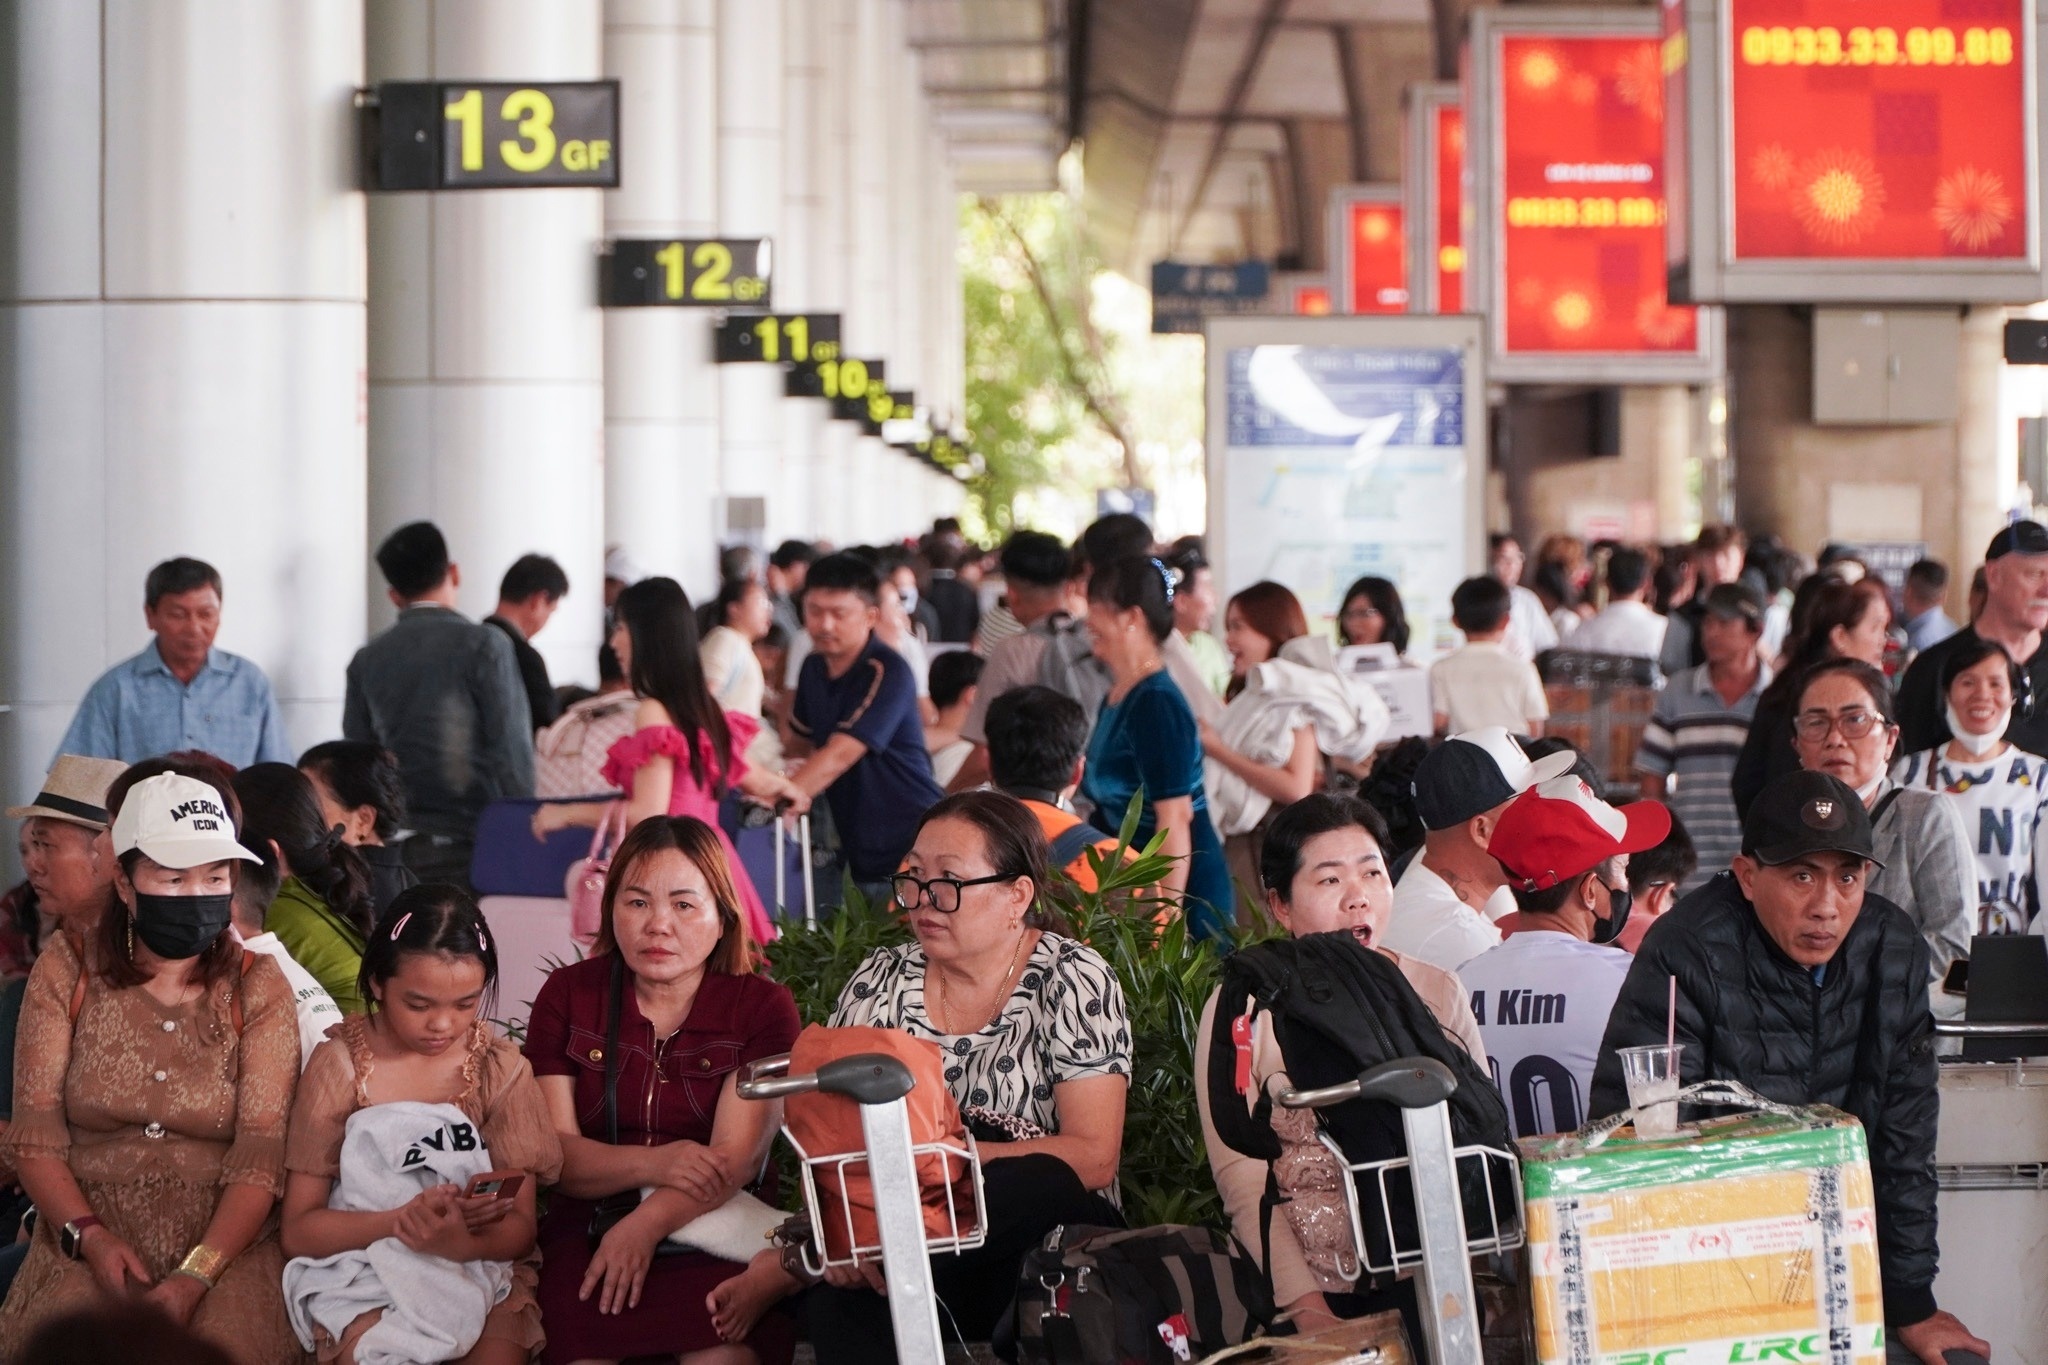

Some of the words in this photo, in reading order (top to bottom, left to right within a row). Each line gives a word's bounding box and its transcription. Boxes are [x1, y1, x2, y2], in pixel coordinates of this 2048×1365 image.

[1743, 26, 2014, 66] 0933.33.99.88
[445, 89, 557, 172] 13
[560, 139, 611, 171] GF
[655, 242, 733, 300] 12
[754, 316, 809, 362] 11
[816, 359, 869, 399] 10
[193, 819, 219, 831] ICON
[1497, 989, 1566, 1025] Kim
[1728, 1335, 1825, 1363] LRC
